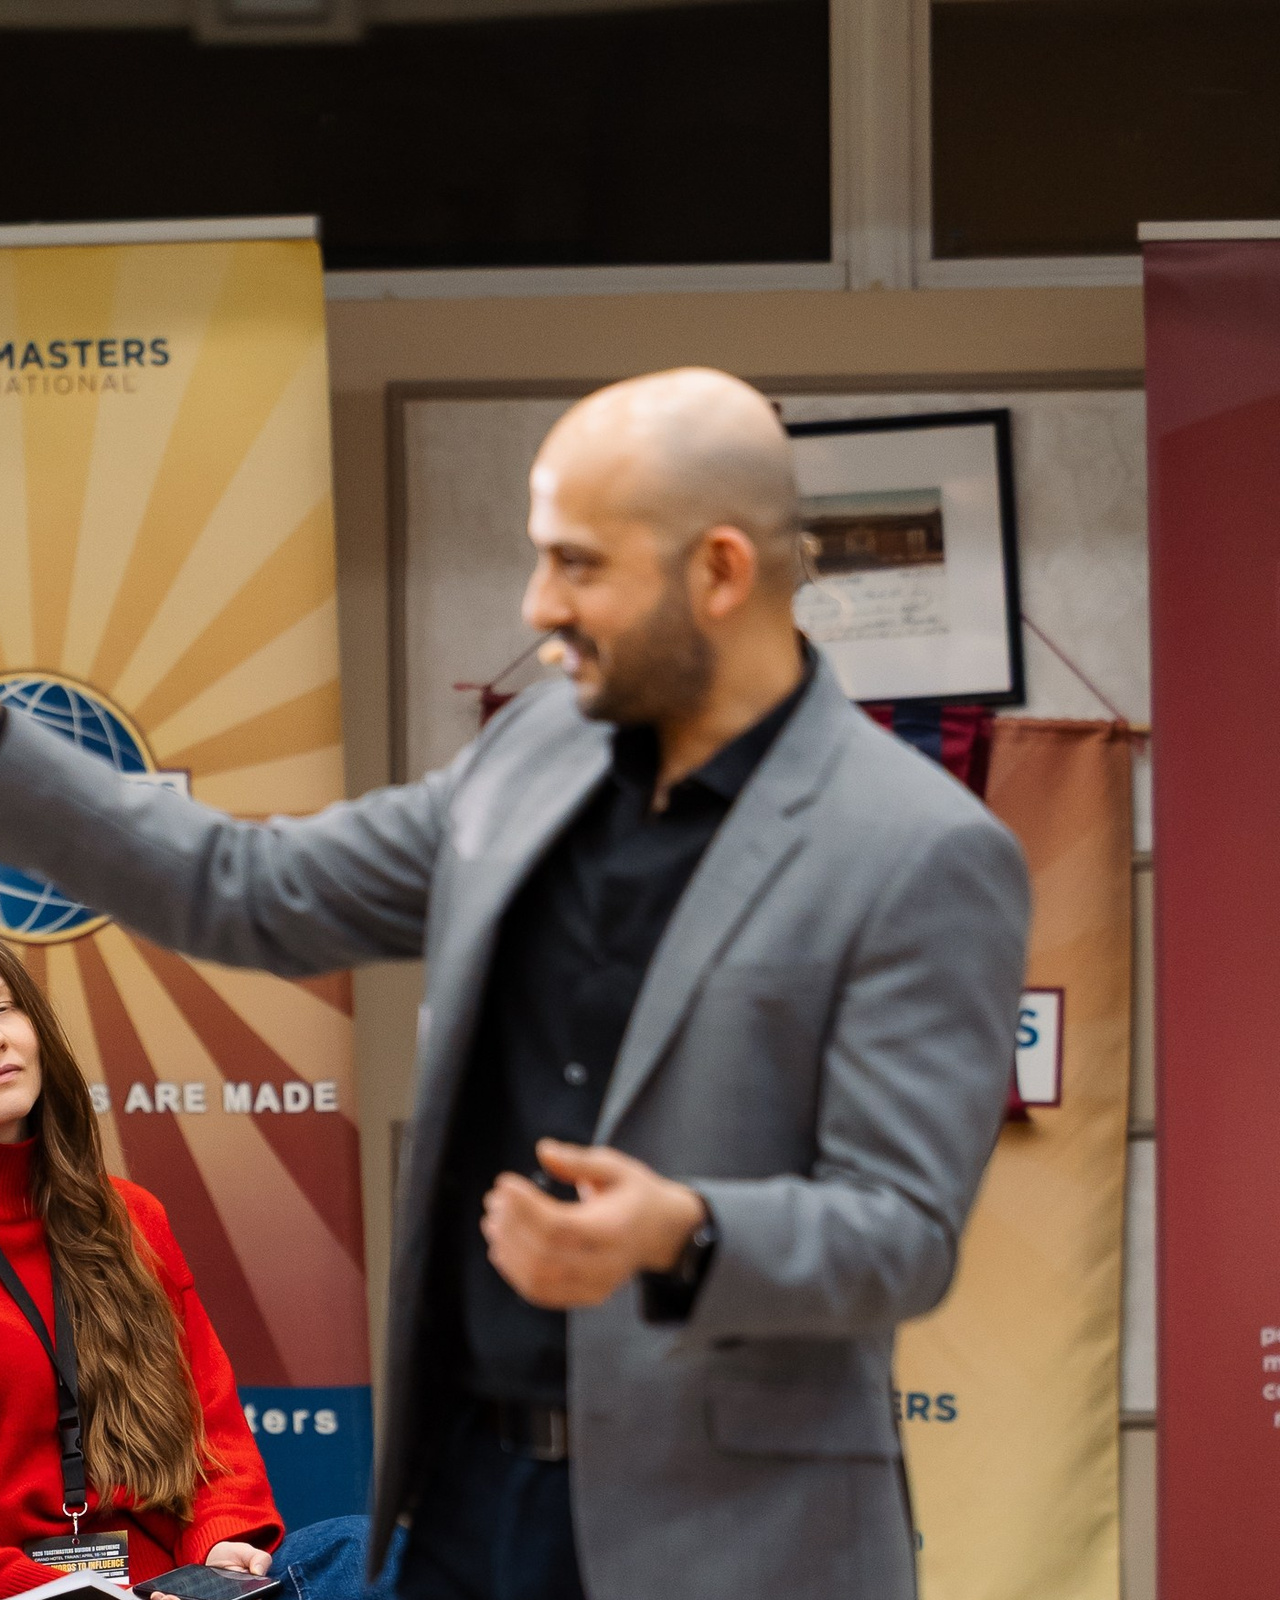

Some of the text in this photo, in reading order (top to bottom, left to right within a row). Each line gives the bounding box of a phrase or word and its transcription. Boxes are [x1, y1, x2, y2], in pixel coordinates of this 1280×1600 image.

[124, 1082, 207, 1114] ARE
[223, 1081, 338, 1113] MADE
[88, 1558, 125, 1570] INFLUENCE
